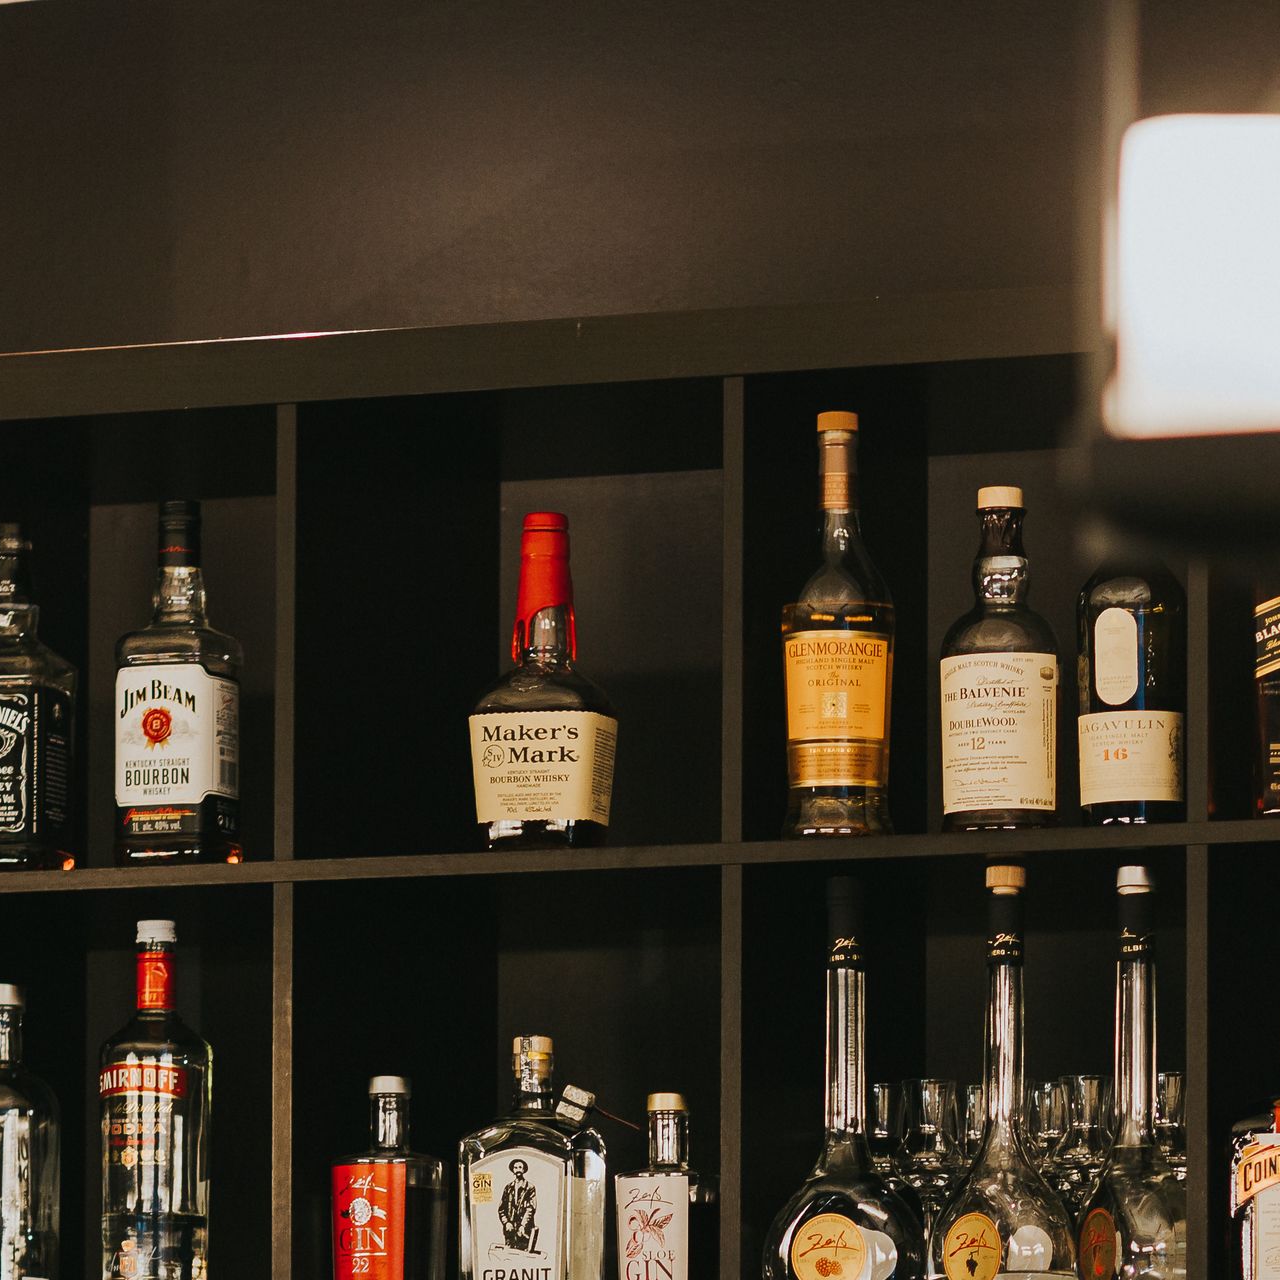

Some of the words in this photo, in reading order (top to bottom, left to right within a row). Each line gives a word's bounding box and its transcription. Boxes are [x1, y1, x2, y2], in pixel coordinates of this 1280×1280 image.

[789, 641, 883, 658] GLENMORANGIE
[957, 661, 971, 669] MALT
[973, 660, 998, 668] SCOTCH
[1000, 663, 1024, 675] WHISKY
[808, 679, 861, 687] ORIGINAL
[120, 687, 146, 718] JIM
[151, 679, 196, 712] BEAM
[944, 692, 958, 702] THE
[960, 687, 1025, 699] BALVENIE
[481, 725, 578, 742] Maker's
[1080, 720, 1165, 734] LAGAVULIN
[971, 736, 985, 750] 12
[508, 746, 578, 764] Mark
[1103, 748, 1128, 760] 16
[125, 759, 156, 769] KENTUCKY
[160, 757, 190, 767] STRAIGHT
[125, 768, 189, 786] BOURBON
[490, 776, 531, 784] BOURBON
[534, 774, 570, 782] WHISKY
[143, 787, 171, 796] WHISKEY
[473, 1180, 492, 1188] GIN
[339, 1227, 387, 1251] GIN
[642, 1250, 675, 1260] SLOE
[351, 1257, 370, 1273] 22
